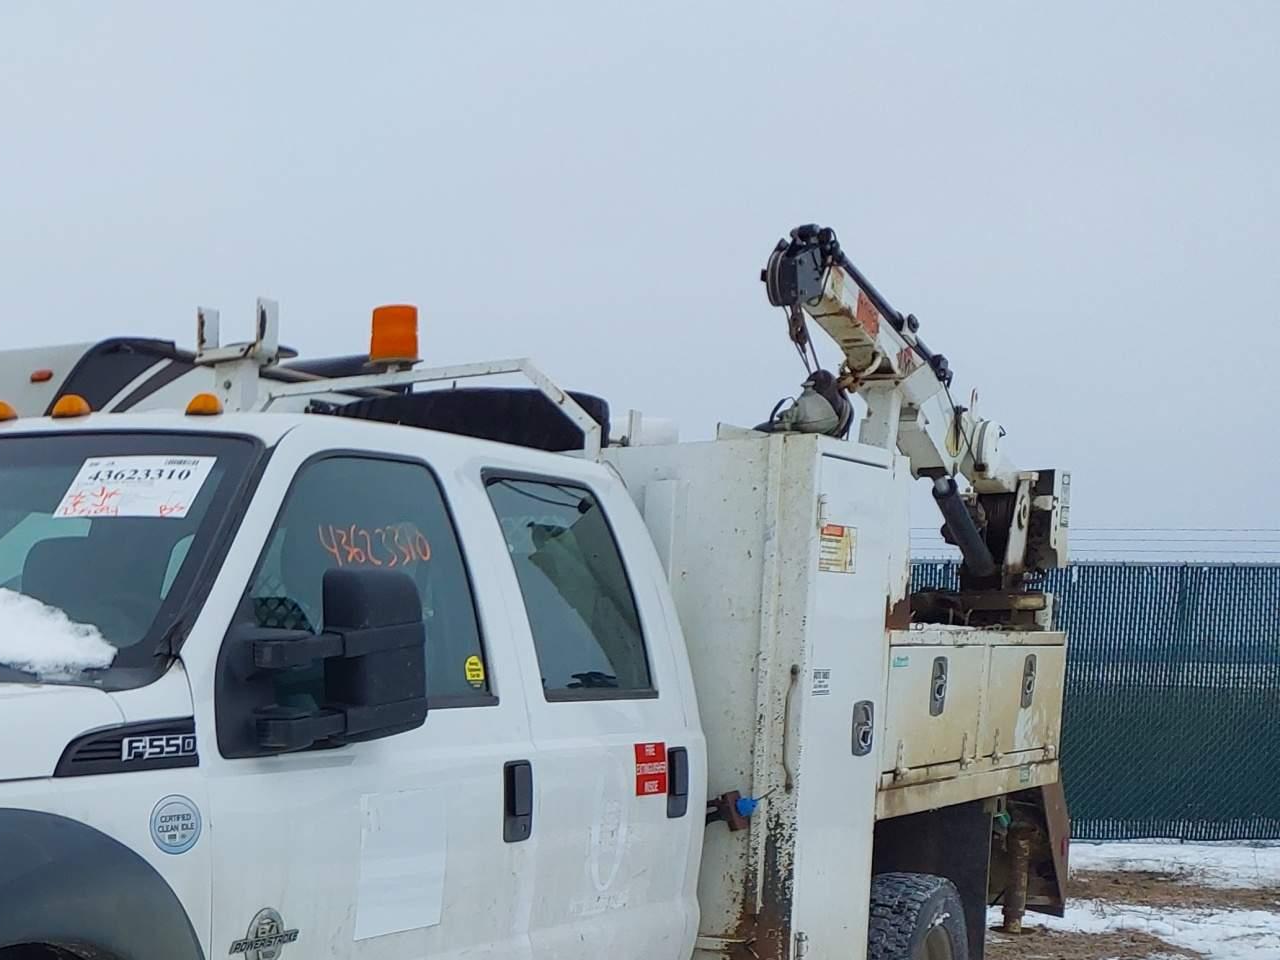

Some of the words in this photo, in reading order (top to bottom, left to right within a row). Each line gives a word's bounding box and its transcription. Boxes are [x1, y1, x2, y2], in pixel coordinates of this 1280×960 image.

[88, 468, 192, 482] 43623310
[318, 524, 431, 567] 43623310
[121, 734, 196, 761] F-550
[160, 813, 192, 823] CERTIFIED
[157, 824, 179, 833] CLEAN
[180, 822, 195, 831] IDLE
